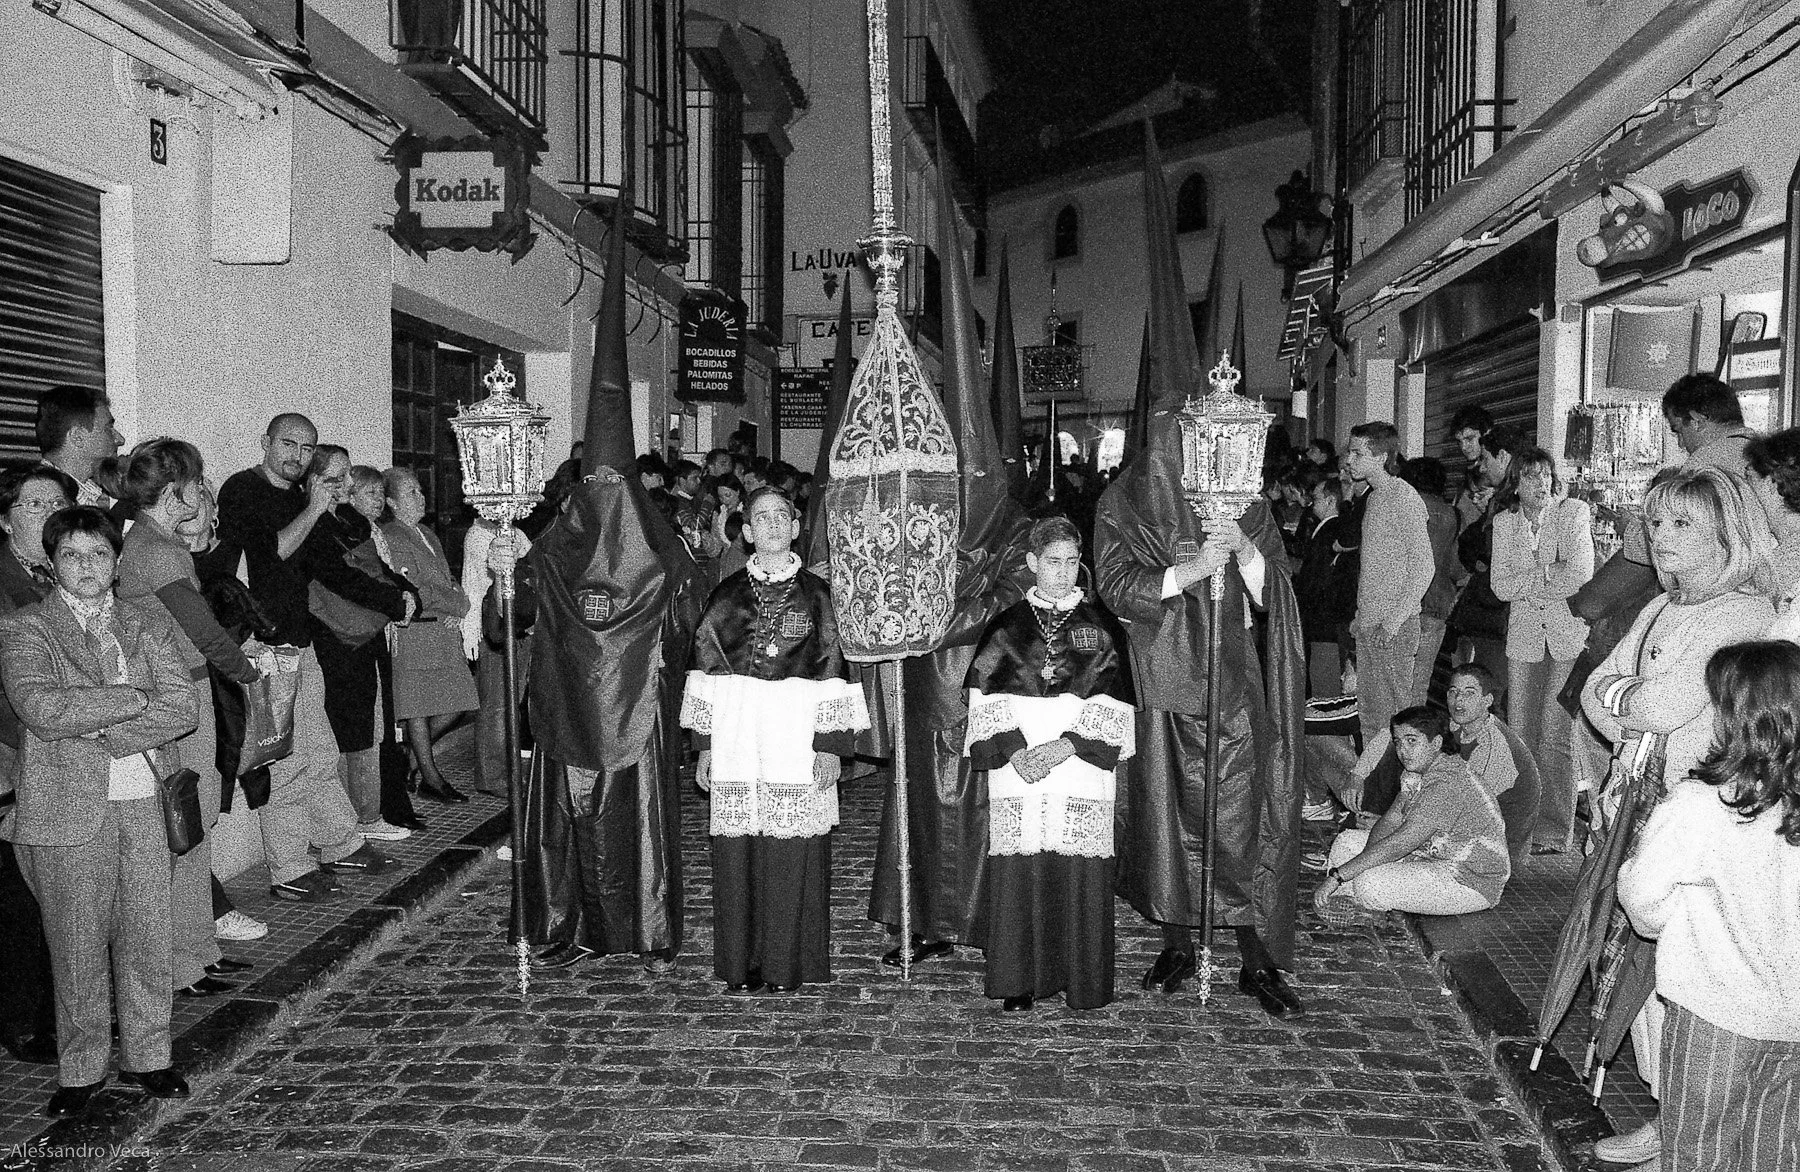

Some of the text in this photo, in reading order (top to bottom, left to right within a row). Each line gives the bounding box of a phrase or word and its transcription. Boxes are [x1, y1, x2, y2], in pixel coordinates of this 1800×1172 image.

[153, 123, 165, 160] 3
[416, 178, 500, 202] Kodak
[811, 320, 870, 338] CAE
[685, 347, 736, 358] BOCADILLOS
[693, 359, 728, 369] BEBIDAS
[687, 370, 733, 380] PALOMITAS
[690, 381, 729, 391] HELADOS
